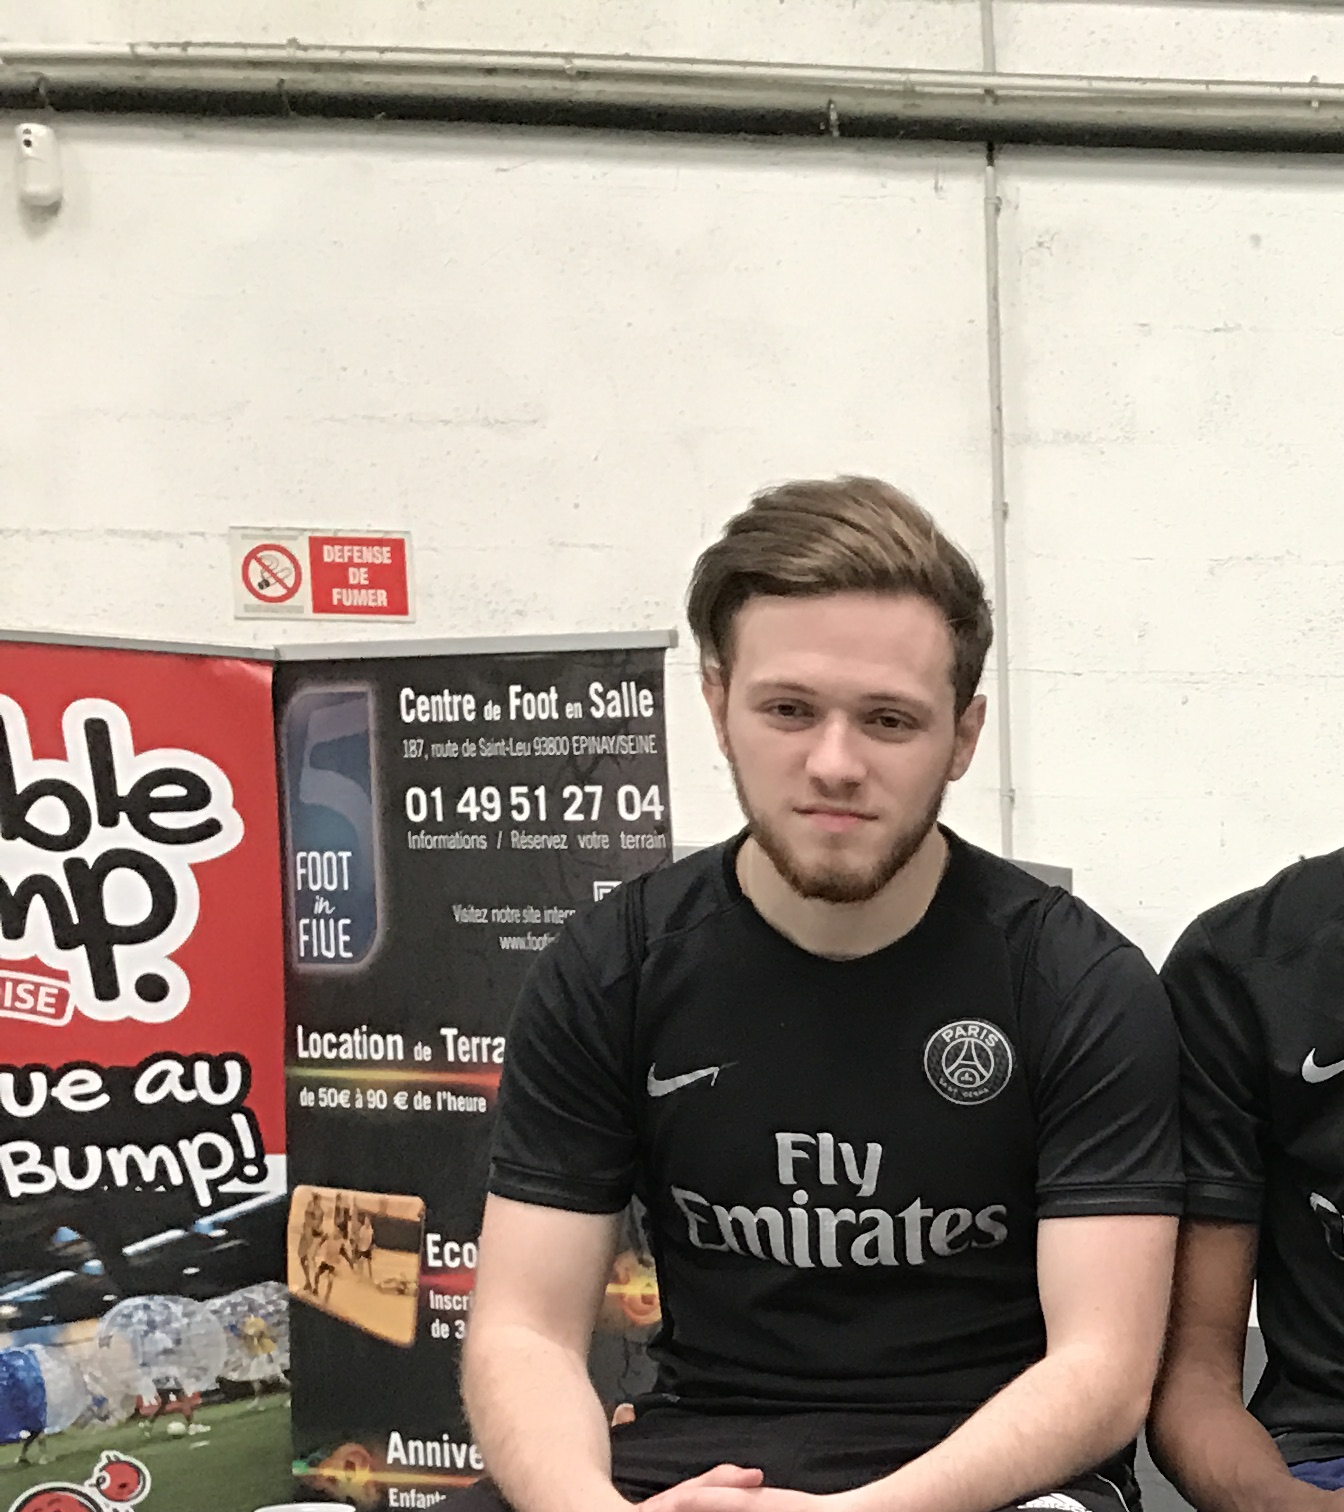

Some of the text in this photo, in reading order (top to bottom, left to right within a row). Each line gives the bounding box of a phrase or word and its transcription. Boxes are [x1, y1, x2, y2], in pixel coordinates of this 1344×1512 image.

[322, 544, 392, 564] DEFENSE
[348, 567, 370, 585] DE
[332, 588, 388, 607] FUMER
[400, 681, 654, 724] Centre de Foot en Salle
[402, 734, 658, 761] 187, route de Saint-Leu 93800 EPINAY/SEINE
[405, 784, 664, 822] 01 49 51 27 04
[407, 830, 487, 850] Informations
[510, 829, 568, 850] Réservez
[577, 832, 609, 849] votre
[620, 830, 667, 849] terrain
[297, 850, 353, 892] FOOT
[313, 895, 335, 915] in
[452, 904, 489, 924] Visitez
[491, 905, 521, 924] notre
[522, 905, 542, 924] site
[296, 1024, 404, 1061] Location
[413, 1041, 432, 1062] de
[941, 1024, 998, 1047] PARIS
[134, 1058, 242, 1105] au
[300, 1086, 487, 1113] de 50€ à 90 € de l'heure
[0, 1113, 259, 1207] Bump!
[775, 1131, 883, 1197] Fly
[671, 1184, 1009, 1268] Emirates
[426, 1232, 477, 1269] Eco
[431, 1318, 450, 1339] de
[388, 1487, 447, 1509] Enfant
